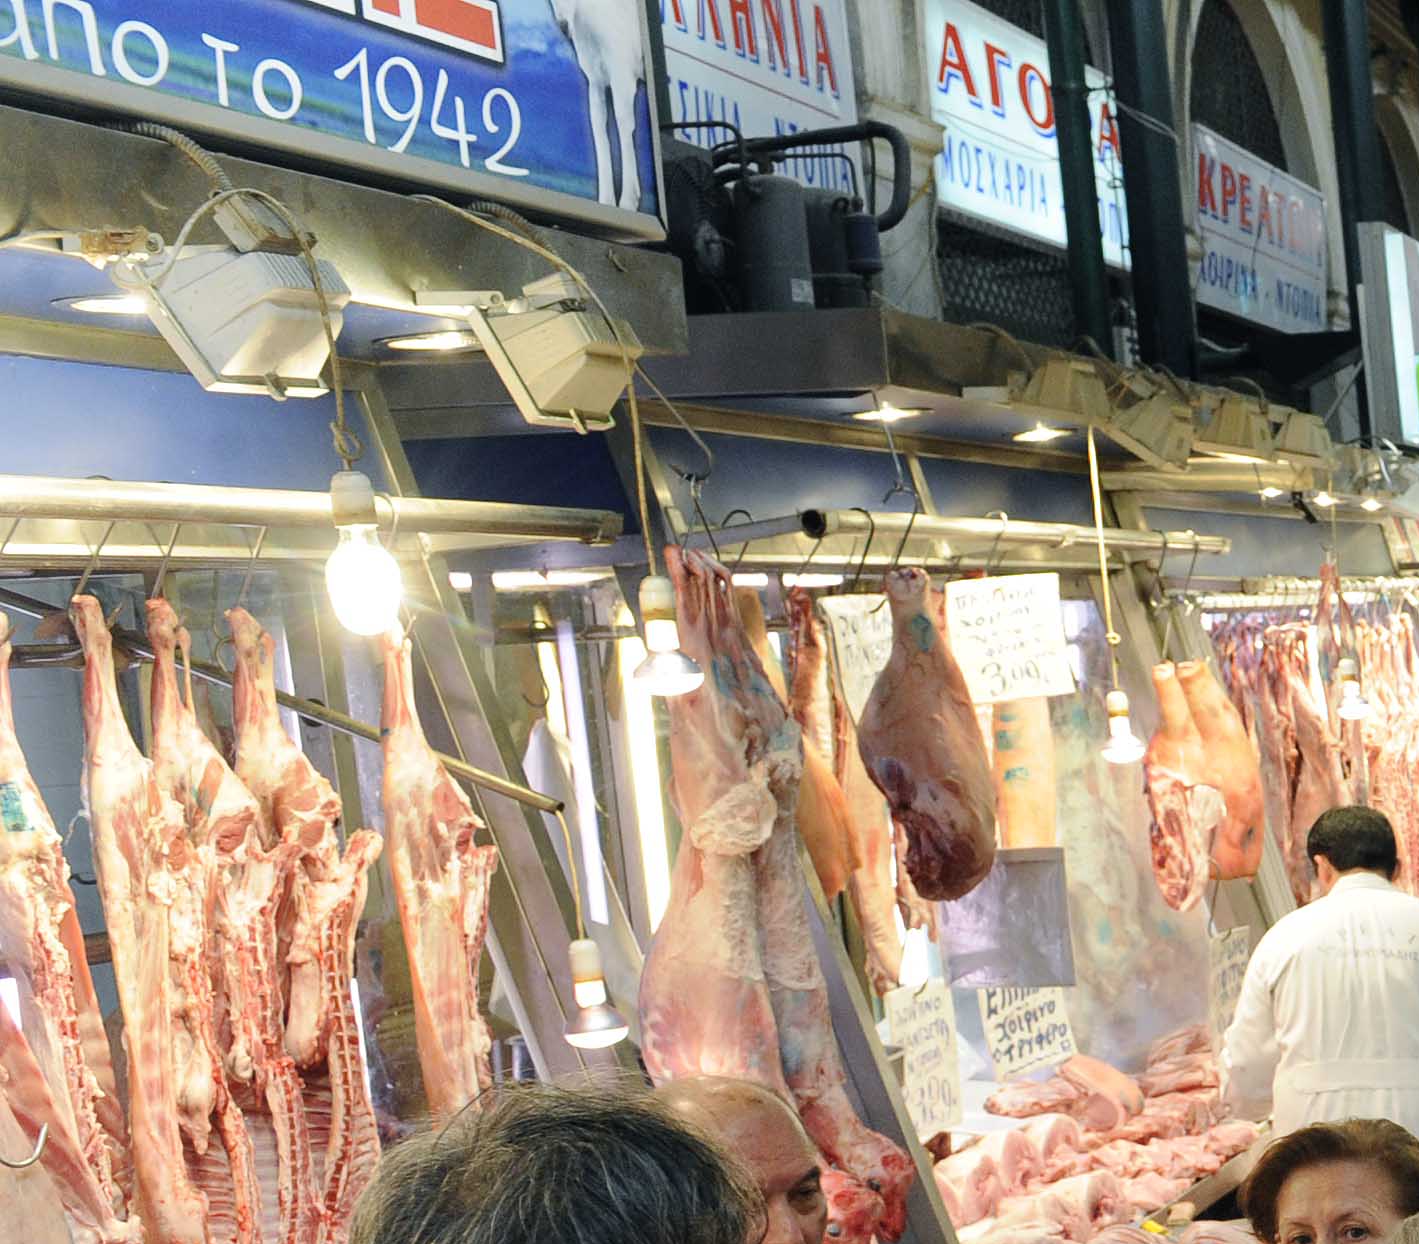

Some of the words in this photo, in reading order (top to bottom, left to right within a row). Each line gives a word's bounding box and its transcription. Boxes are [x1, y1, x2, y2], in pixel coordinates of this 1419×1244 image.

[334, 48, 530, 176] 1942
[937, 22, 1123, 163] ΑΓΟΑ
[943, 135, 1048, 216] ΜΟΣΧΑΡΙΑ
